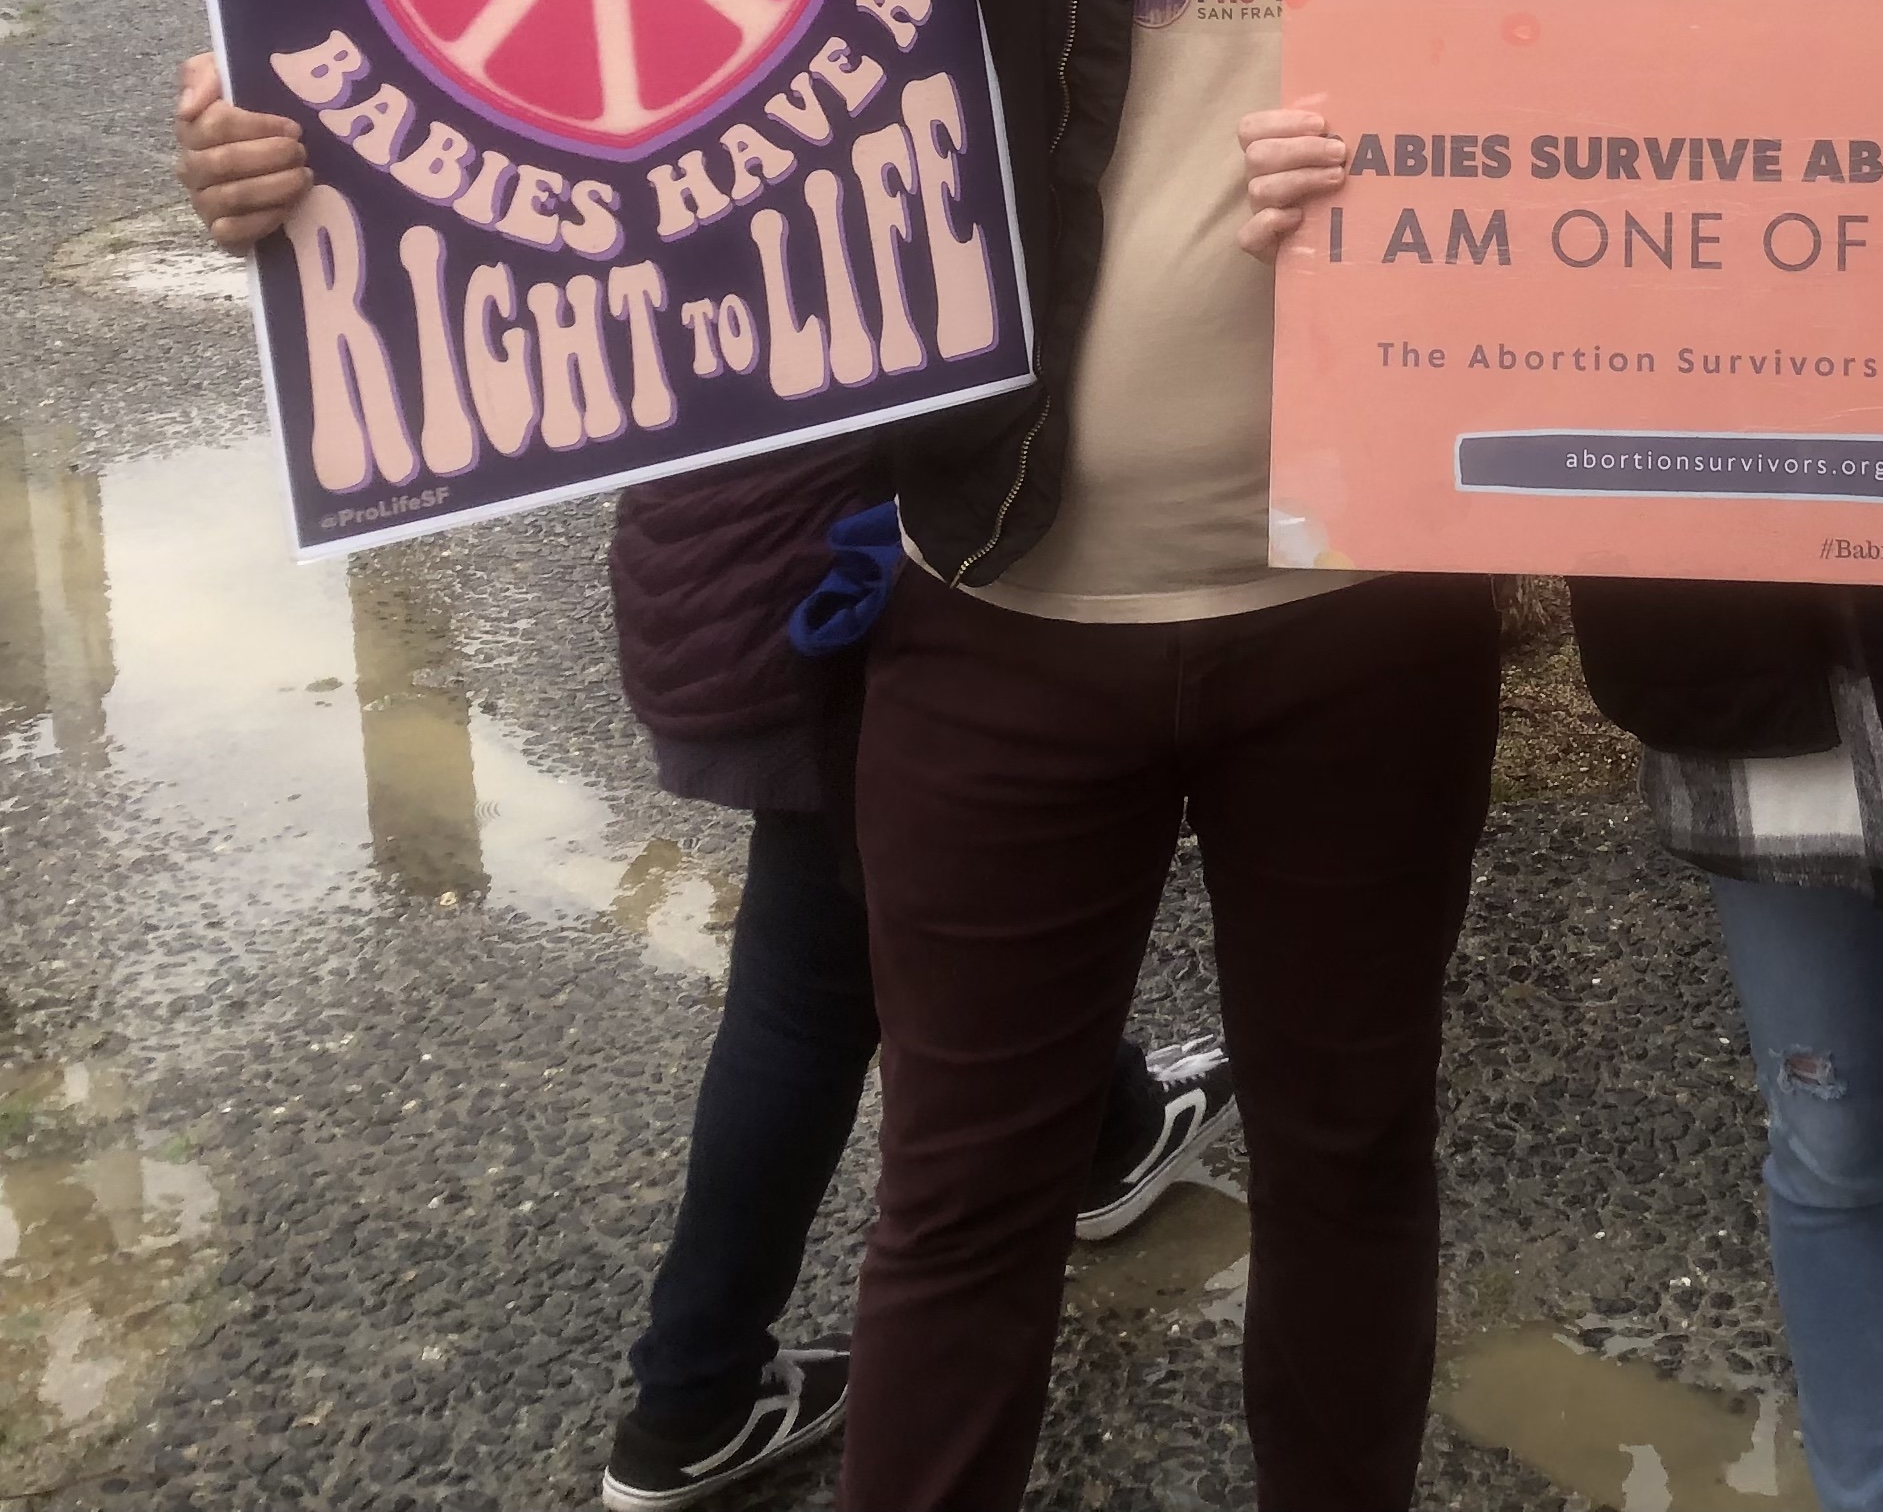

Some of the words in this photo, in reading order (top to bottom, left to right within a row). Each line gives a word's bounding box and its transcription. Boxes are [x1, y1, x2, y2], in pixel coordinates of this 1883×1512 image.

[1197, 7, 1233, 20] SAN
[269, 29, 625, 260] BABIES
[646, 36, 885, 244] HAVE
[1322, 133, 1512, 179] ABIES
[1531, 134, 1783, 183] SURVIVE
[1329, 207, 1344, 263] I
[1381, 208, 1512, 266] AM
[1551, 208, 1723, 270] ONE
[1762, 212, 1869, 272] OF
[285, 184, 678, 491] RIGHT
[680, 298, 757, 379] TO
[750, 72, 1000, 400] LIFE
[1377, 341, 1446, 369] The
[1467, 343, 1655, 373] Abortion
[1677, 347, 1878, 379] Survivors
[320, 486, 451, 529] @ProLifeSF
